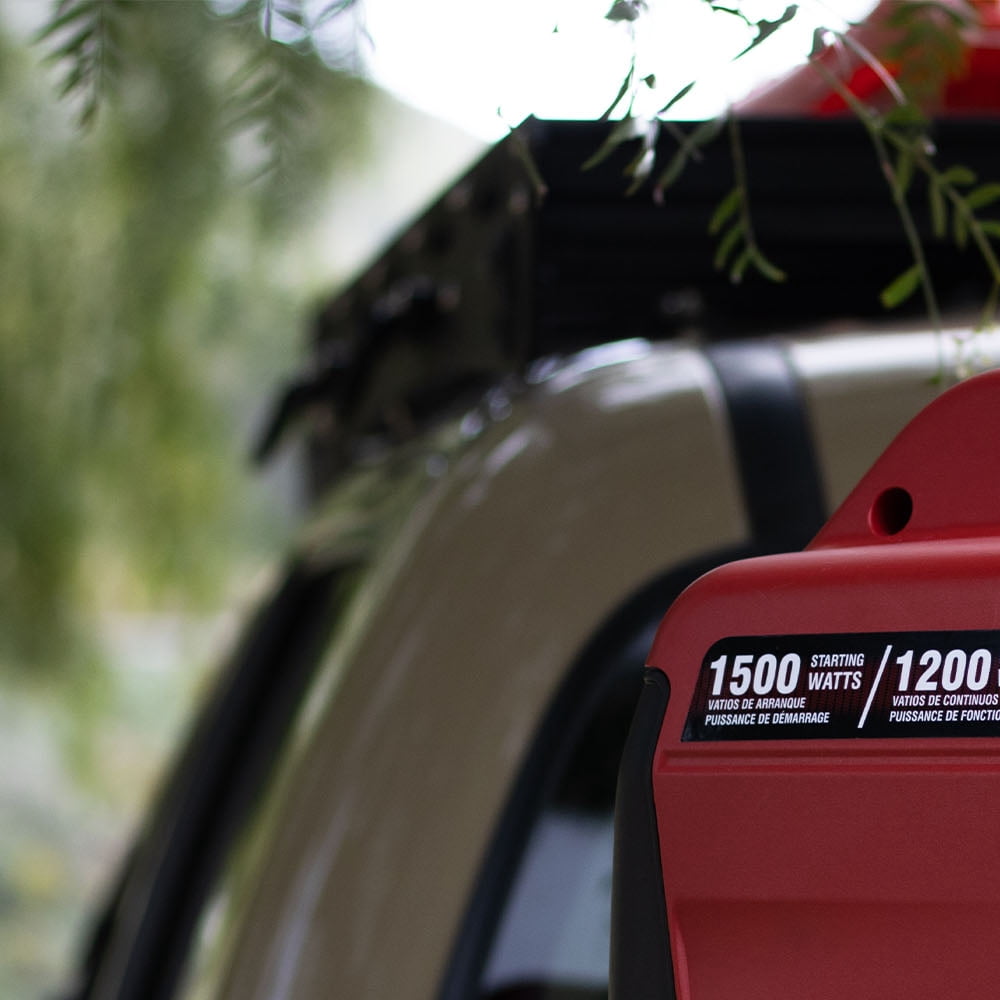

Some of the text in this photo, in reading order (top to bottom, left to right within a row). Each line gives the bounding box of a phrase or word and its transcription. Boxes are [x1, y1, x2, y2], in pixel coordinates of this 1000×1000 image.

[811, 653, 865, 668] STARTING
[710, 653, 801, 696] 1500
[896, 649, 992, 691] 1200
[808, 671, 863, 691] WATTS
[708, 697, 806, 710] VATIOS DE ARRANQUE
[892, 694, 999, 706] VATIOS DE CONTINUOS
[705, 710, 830, 726] PUISSANCE DE DÉMARRAGE
[889, 710, 943, 722] PUISSANCE
[945, 710, 958, 721] DE
